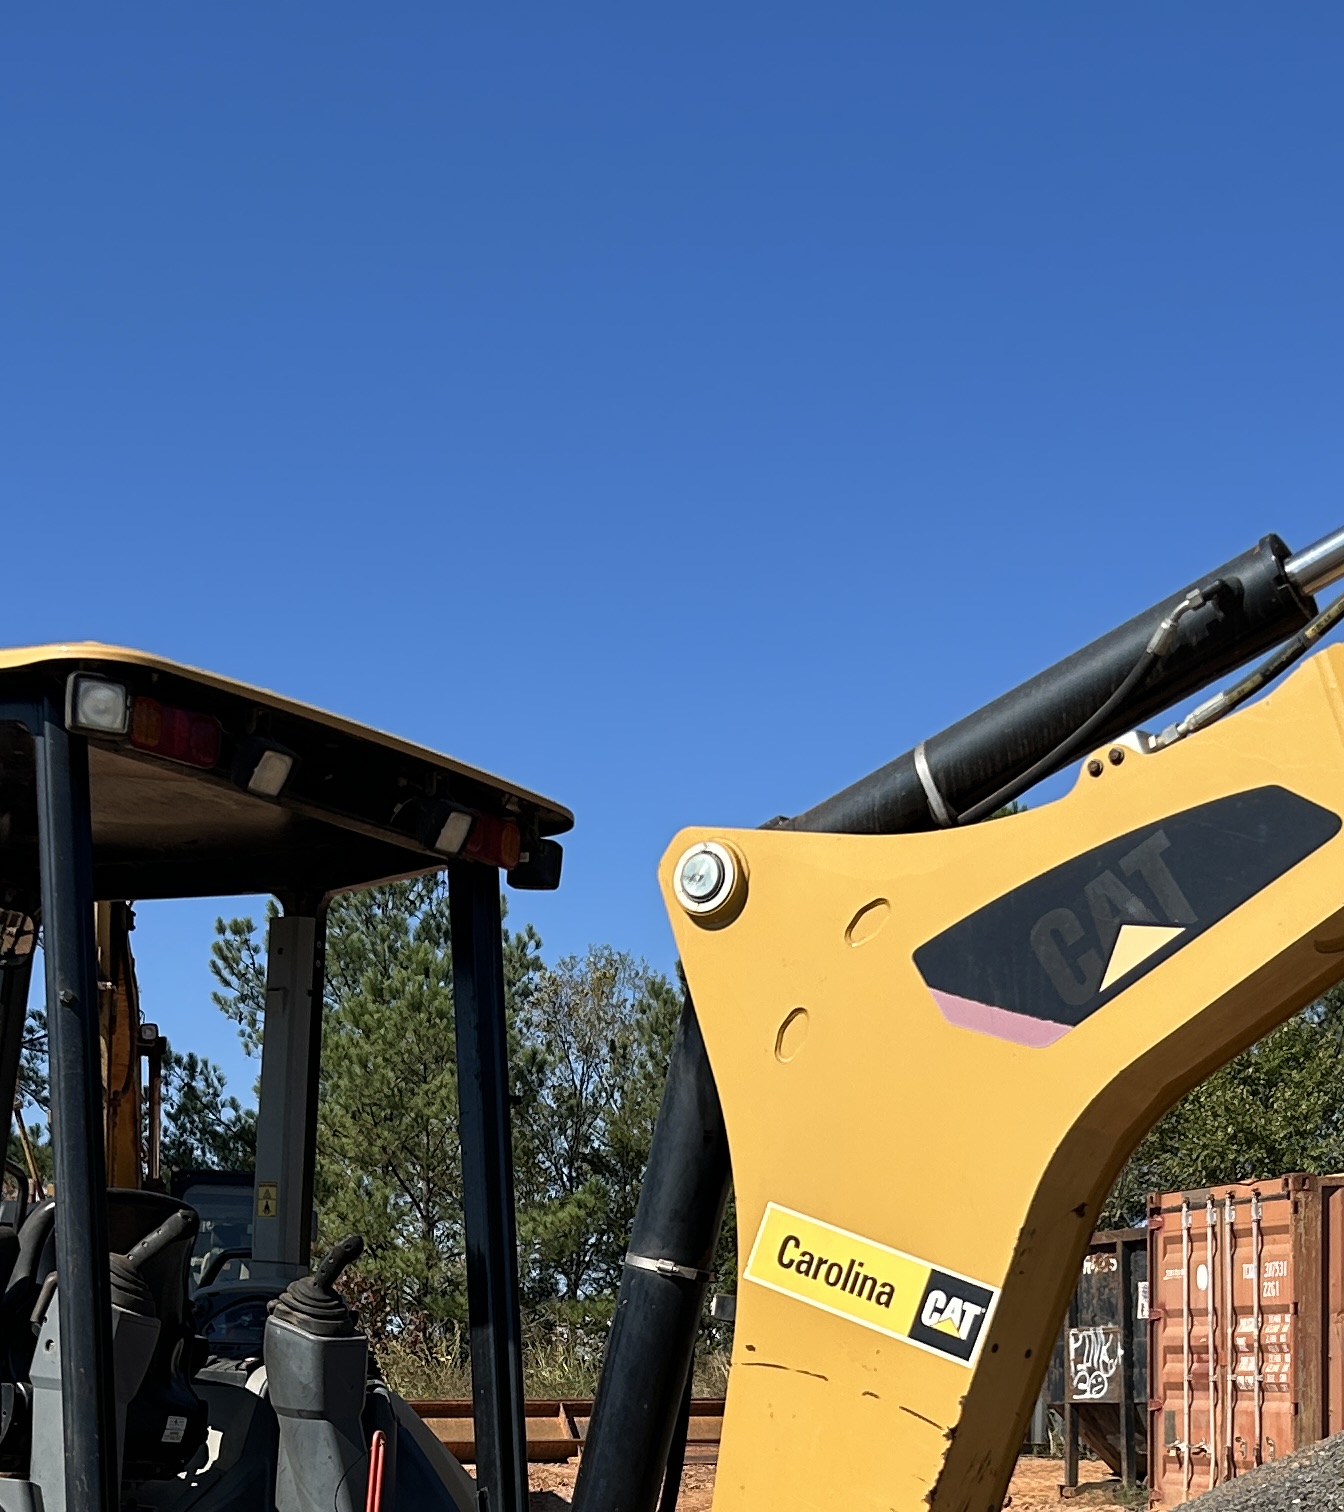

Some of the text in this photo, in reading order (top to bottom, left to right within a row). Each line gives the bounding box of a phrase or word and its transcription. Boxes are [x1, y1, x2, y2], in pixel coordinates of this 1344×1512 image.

[1030, 829, 1199, 1005] CAT
[777, 1235, 982, 1341] Carolina CAT
